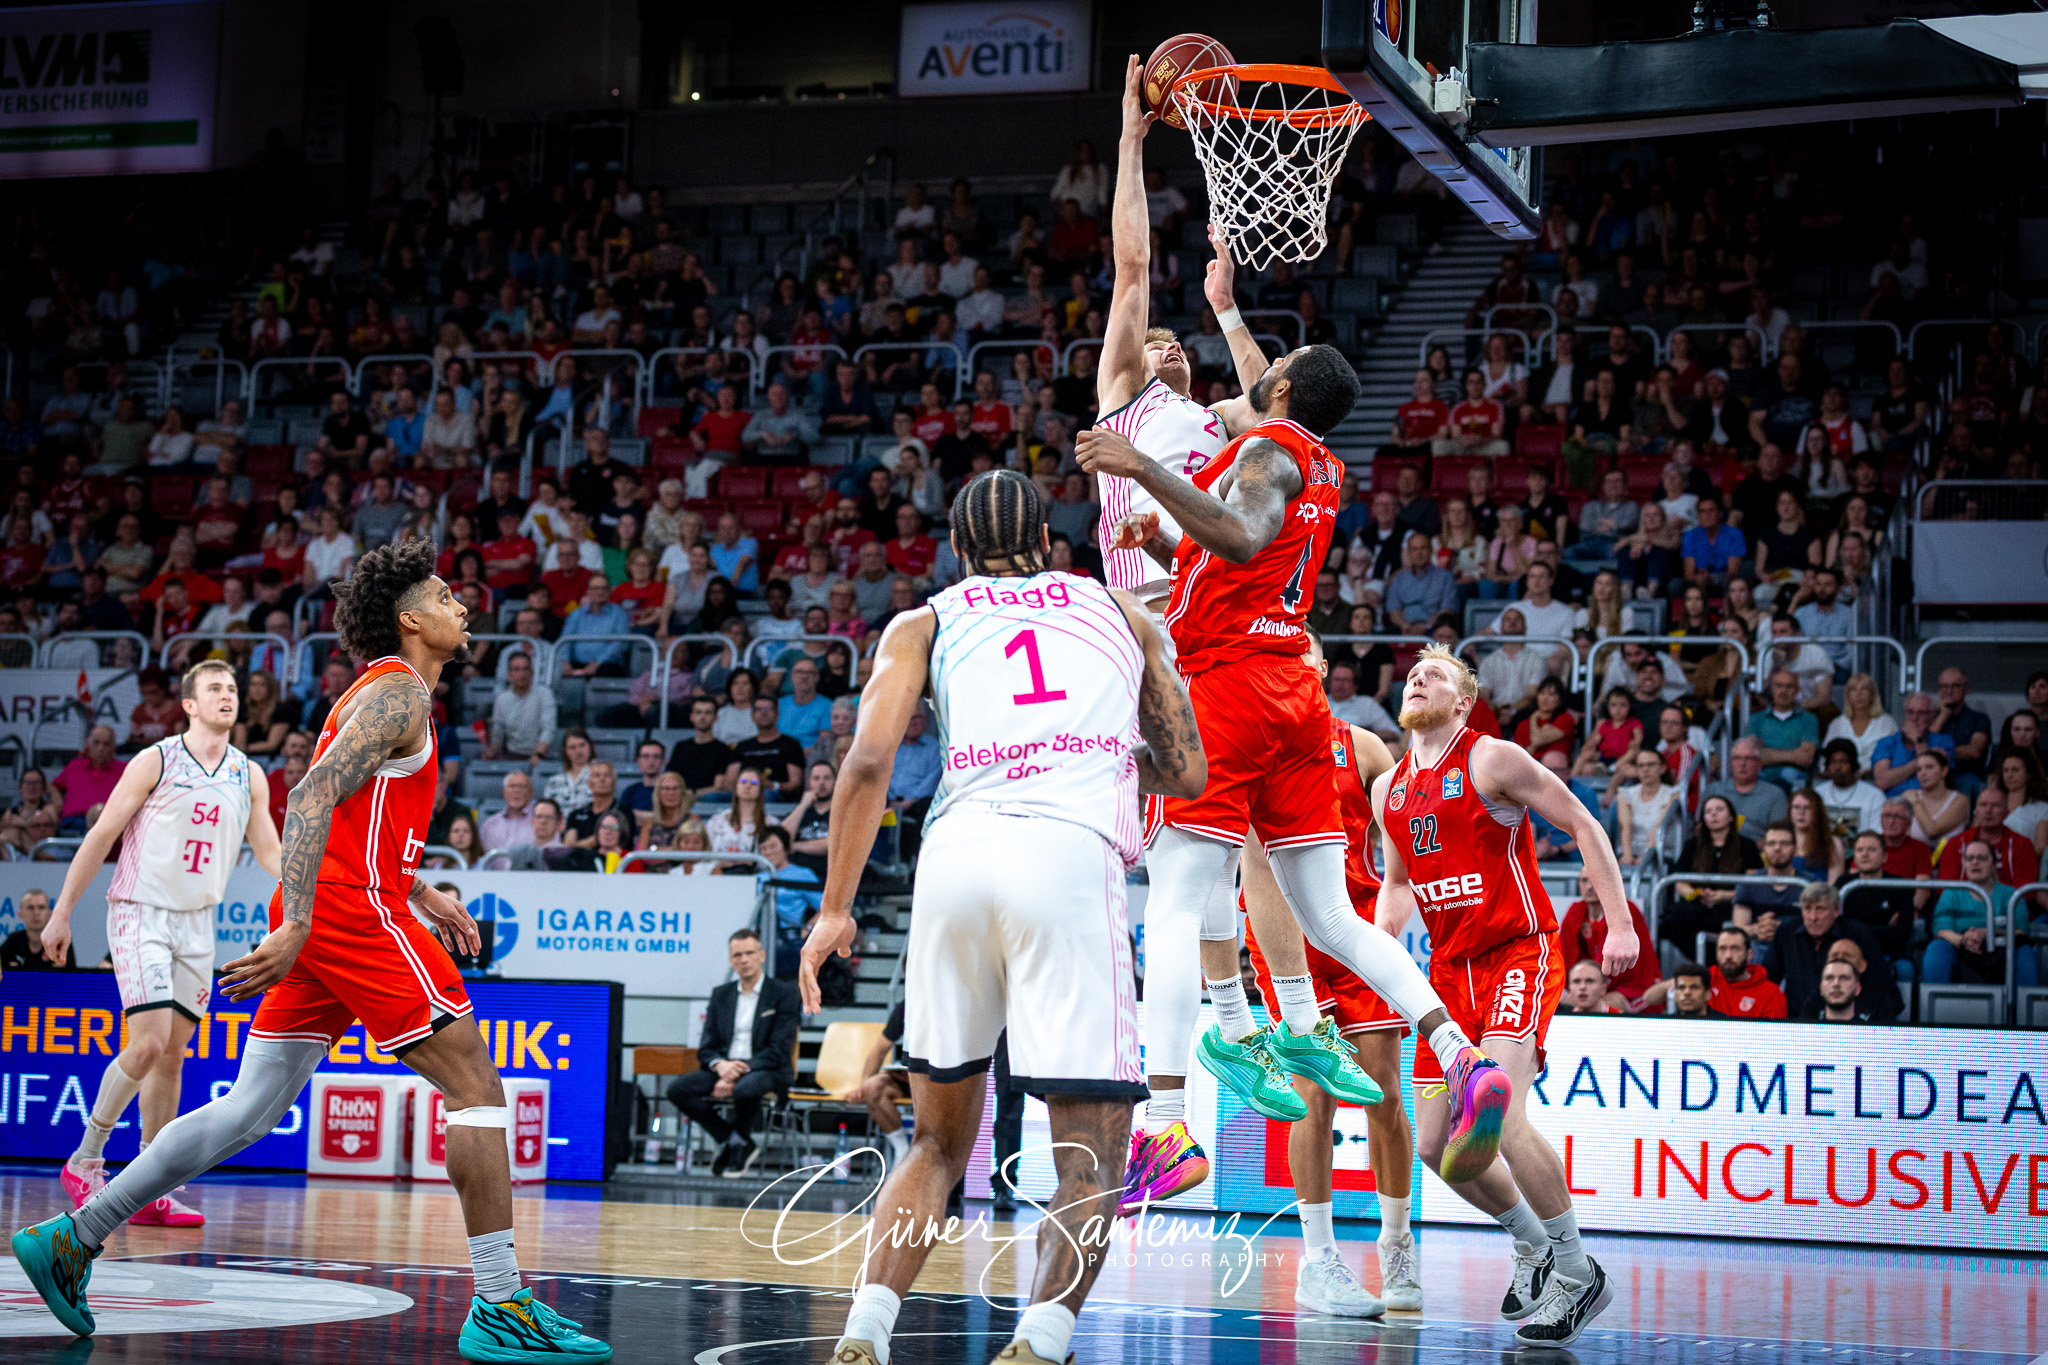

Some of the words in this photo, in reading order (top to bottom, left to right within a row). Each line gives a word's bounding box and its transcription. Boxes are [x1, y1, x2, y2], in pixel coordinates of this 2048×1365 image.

[0, 89, 150, 115] ERSICHERUNG
[1279, 534, 1315, 615] 4
[963, 580, 1071, 609] Flagg
[1004, 629, 1067, 706] 1
[946, 741, 1047, 771] Telekom
[191, 802, 220, 827] 54
[1410, 813, 1442, 857] 22
[538, 908, 691, 934] IGARASHI
[537, 936, 629, 952] MOTOREN
[635, 937, 690, 954] GMBH
[328, 1095, 378, 1118] RHÖN
[327, 1118, 376, 1132] SPRUDEL
[1633, 1137, 2048, 1217] INCLUSIVE
